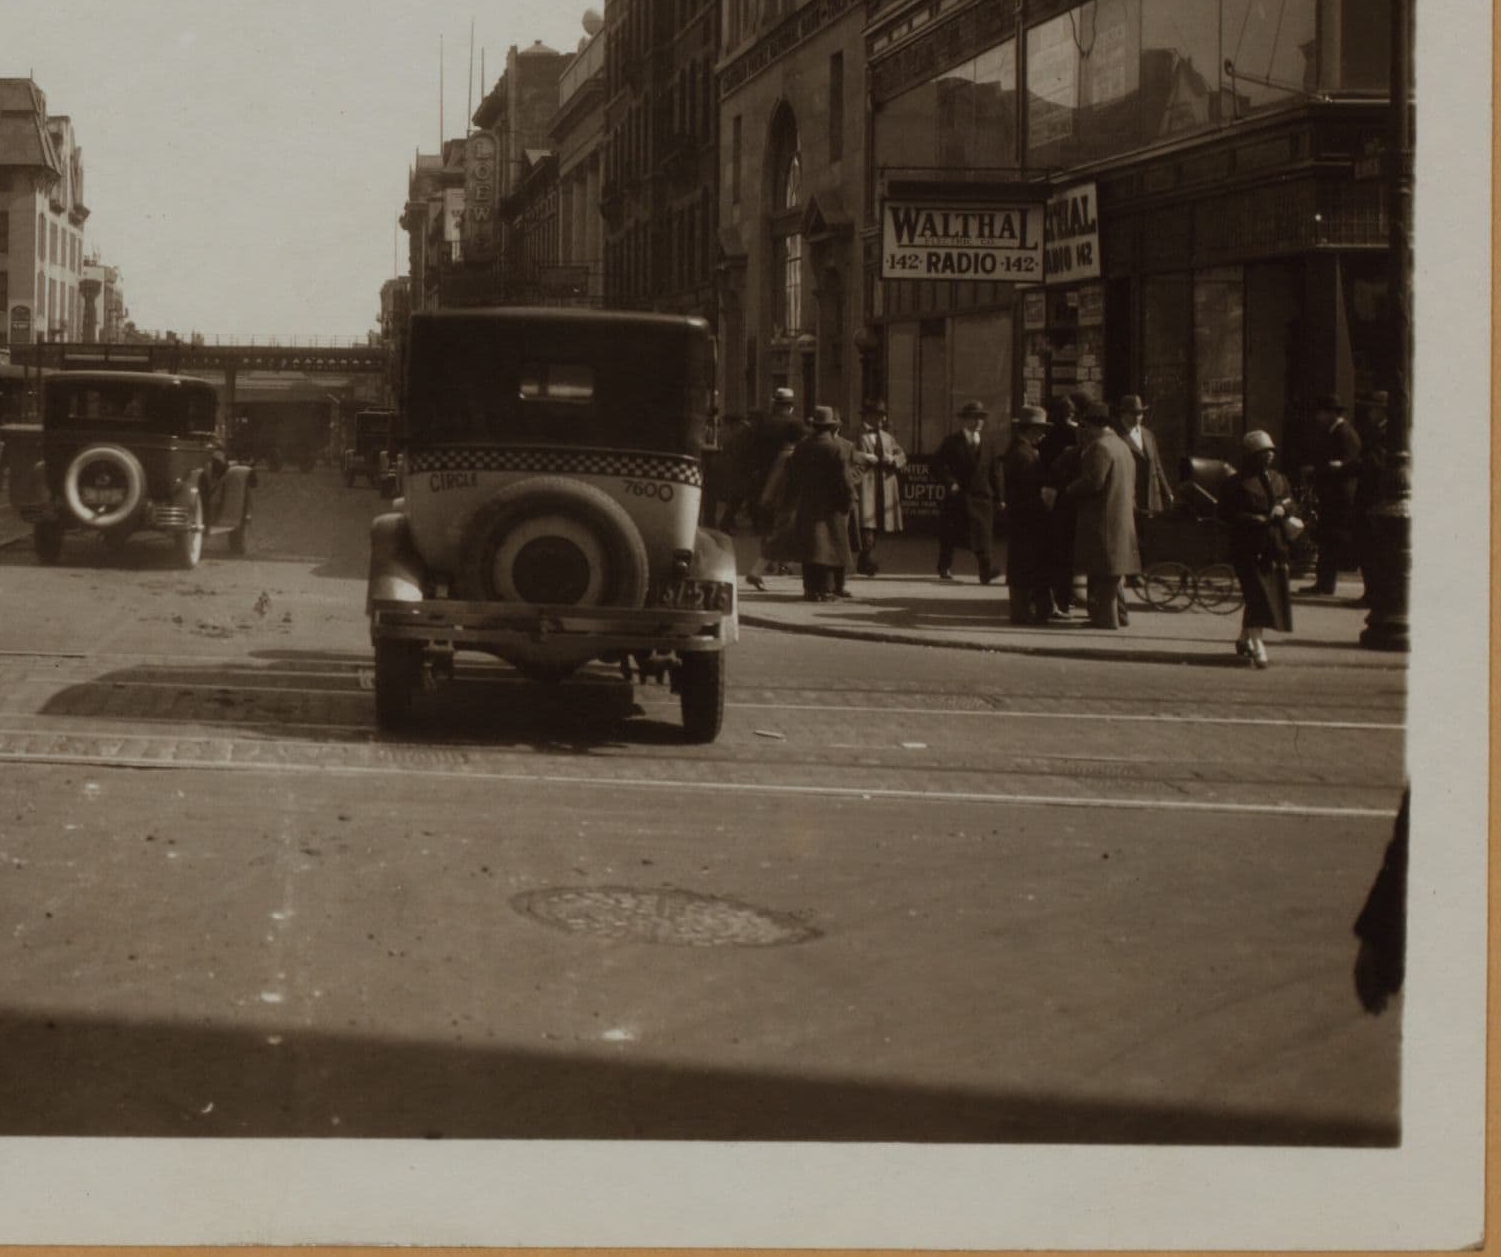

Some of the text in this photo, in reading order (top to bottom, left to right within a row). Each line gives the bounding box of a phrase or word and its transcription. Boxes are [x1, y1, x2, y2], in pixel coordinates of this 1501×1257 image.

[887, 206, 1039, 250] WALTHAL
[926, 251, 998, 275] RADIO
[621, 479, 676, 503] 7600
